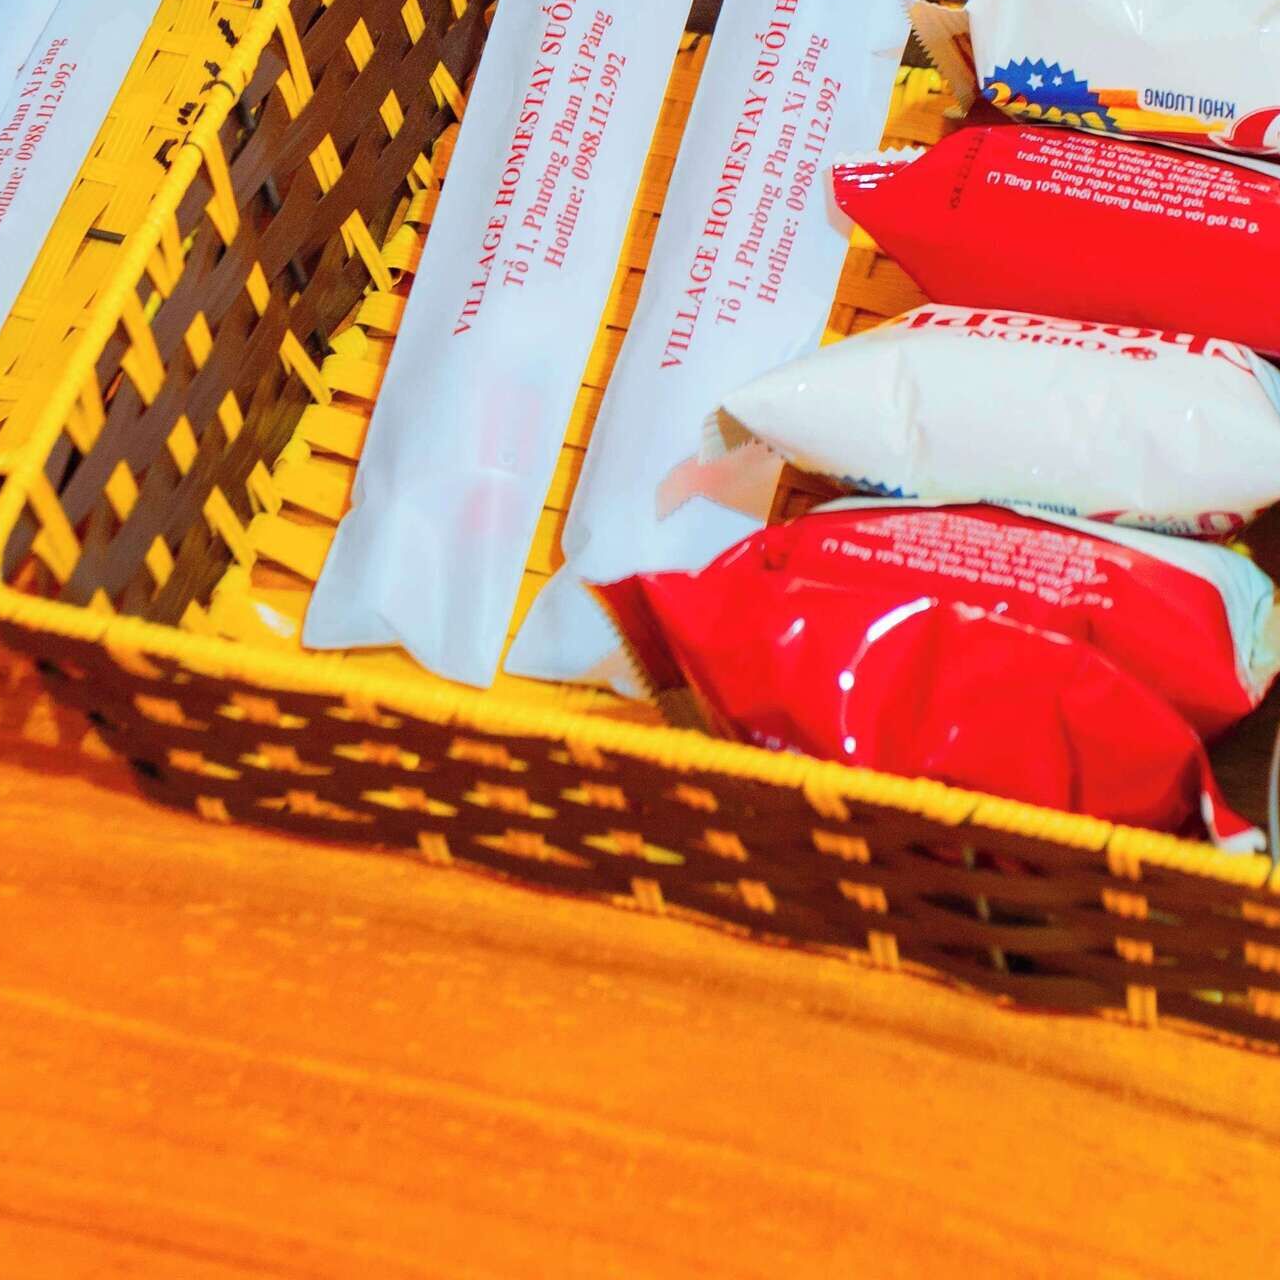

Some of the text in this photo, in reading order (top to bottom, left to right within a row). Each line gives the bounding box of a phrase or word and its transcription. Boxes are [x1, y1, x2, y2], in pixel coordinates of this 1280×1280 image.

[15, 62, 78, 162] 0988.112.992
[20, 80, 43, 98] Xi
[453, 214, 508, 337] VILLAGE
[494, 60, 557, 208] HOMESTAY
[503, 9, 615, 288] Tổ 1, Phường Phan Xi Păng
[544, 51, 628, 269] Hotline: 0988.112.992
[660, 245, 720, 370] VILLAGE
[703, 88, 770, 240] HOMESTAY
[753, 19, 792, 85] SUỐI
[715, 34, 831, 326] Tổ 1, Phường Phan Xi Păng
[756, 76, 843, 305] Hotline: 0988.112.992
[1002, 173, 1033, 192] Tăng
[1035, 180, 1063, 196] 10%
[1064, 186, 1092, 204] khối
[1092, 191, 1131, 211] lượng
[1132, 198, 1165, 217] bánh
[1166, 206, 1183, 219] so
[1184, 208, 1205, 223] với
[1206, 212, 1229, 229] gói
[1230, 218, 1246, 231] 33
[967, 330, 1108, 351] ORION
